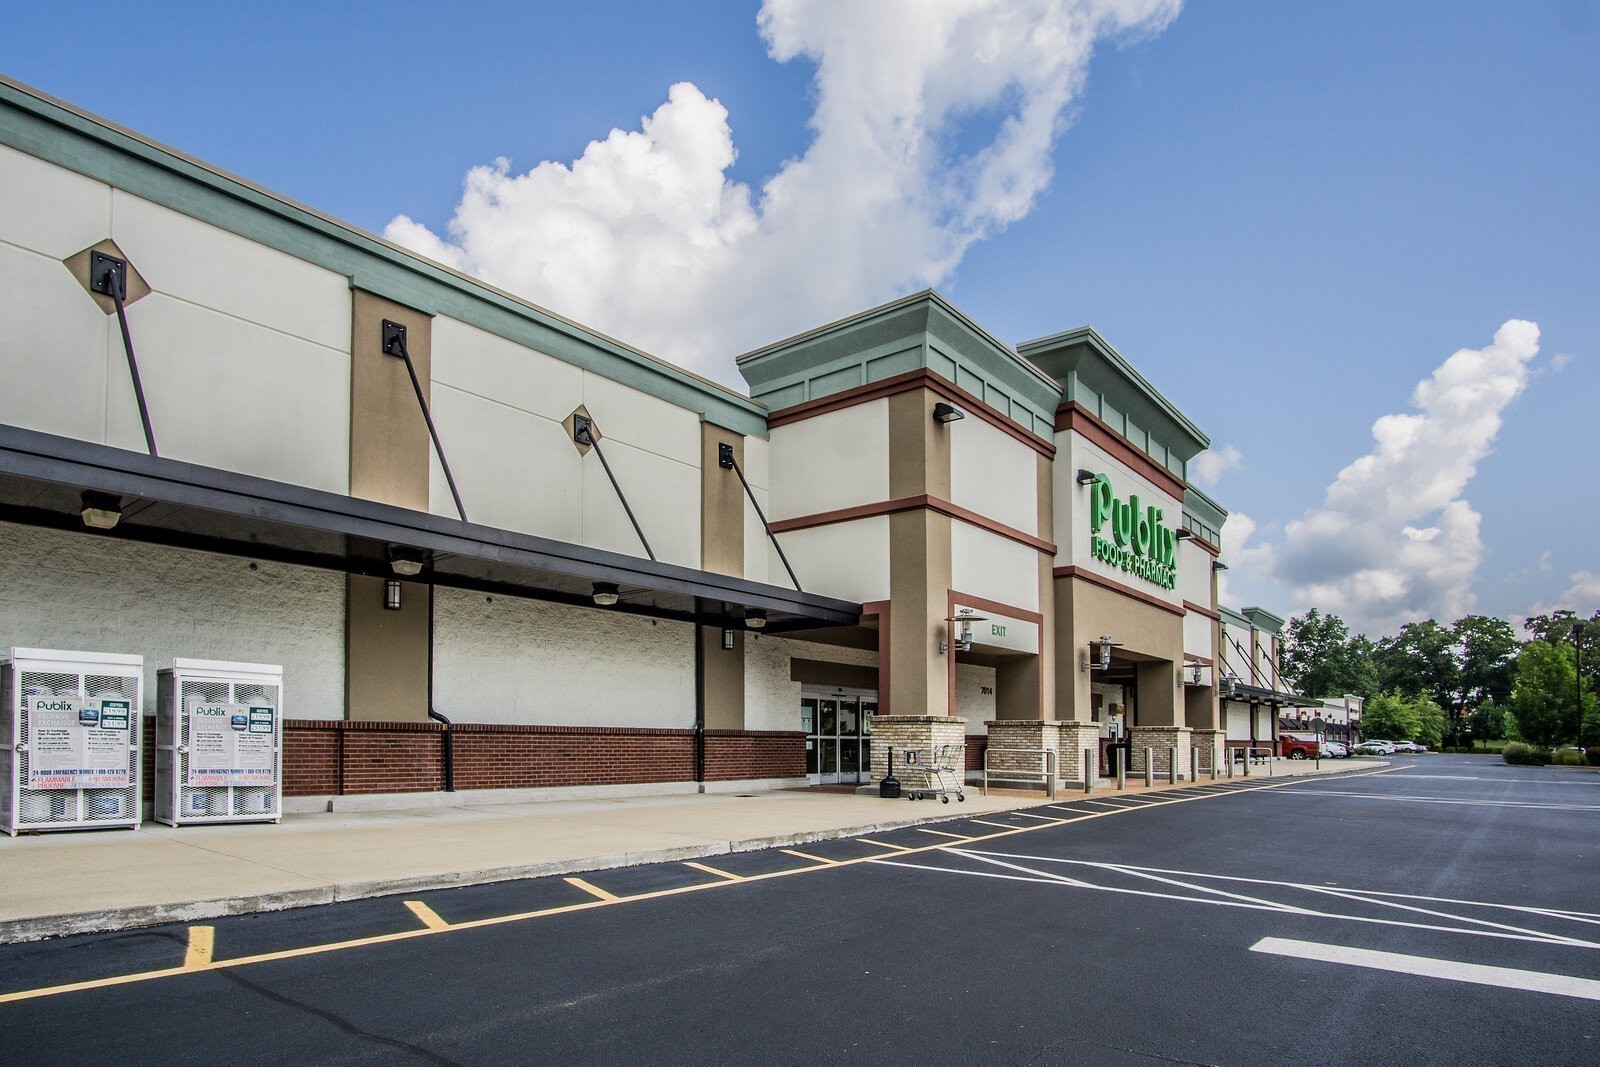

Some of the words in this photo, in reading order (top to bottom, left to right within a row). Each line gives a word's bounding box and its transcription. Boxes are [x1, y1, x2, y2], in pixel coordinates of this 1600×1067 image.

[1091, 473, 1177, 570] Publix
[1091, 536, 1123, 566] FOOD
[991, 624, 1007, 637] EXIT
[981, 686, 992, 695] 7014
[37, 700, 72, 711] Publix
[196, 706, 226, 716] Publix
